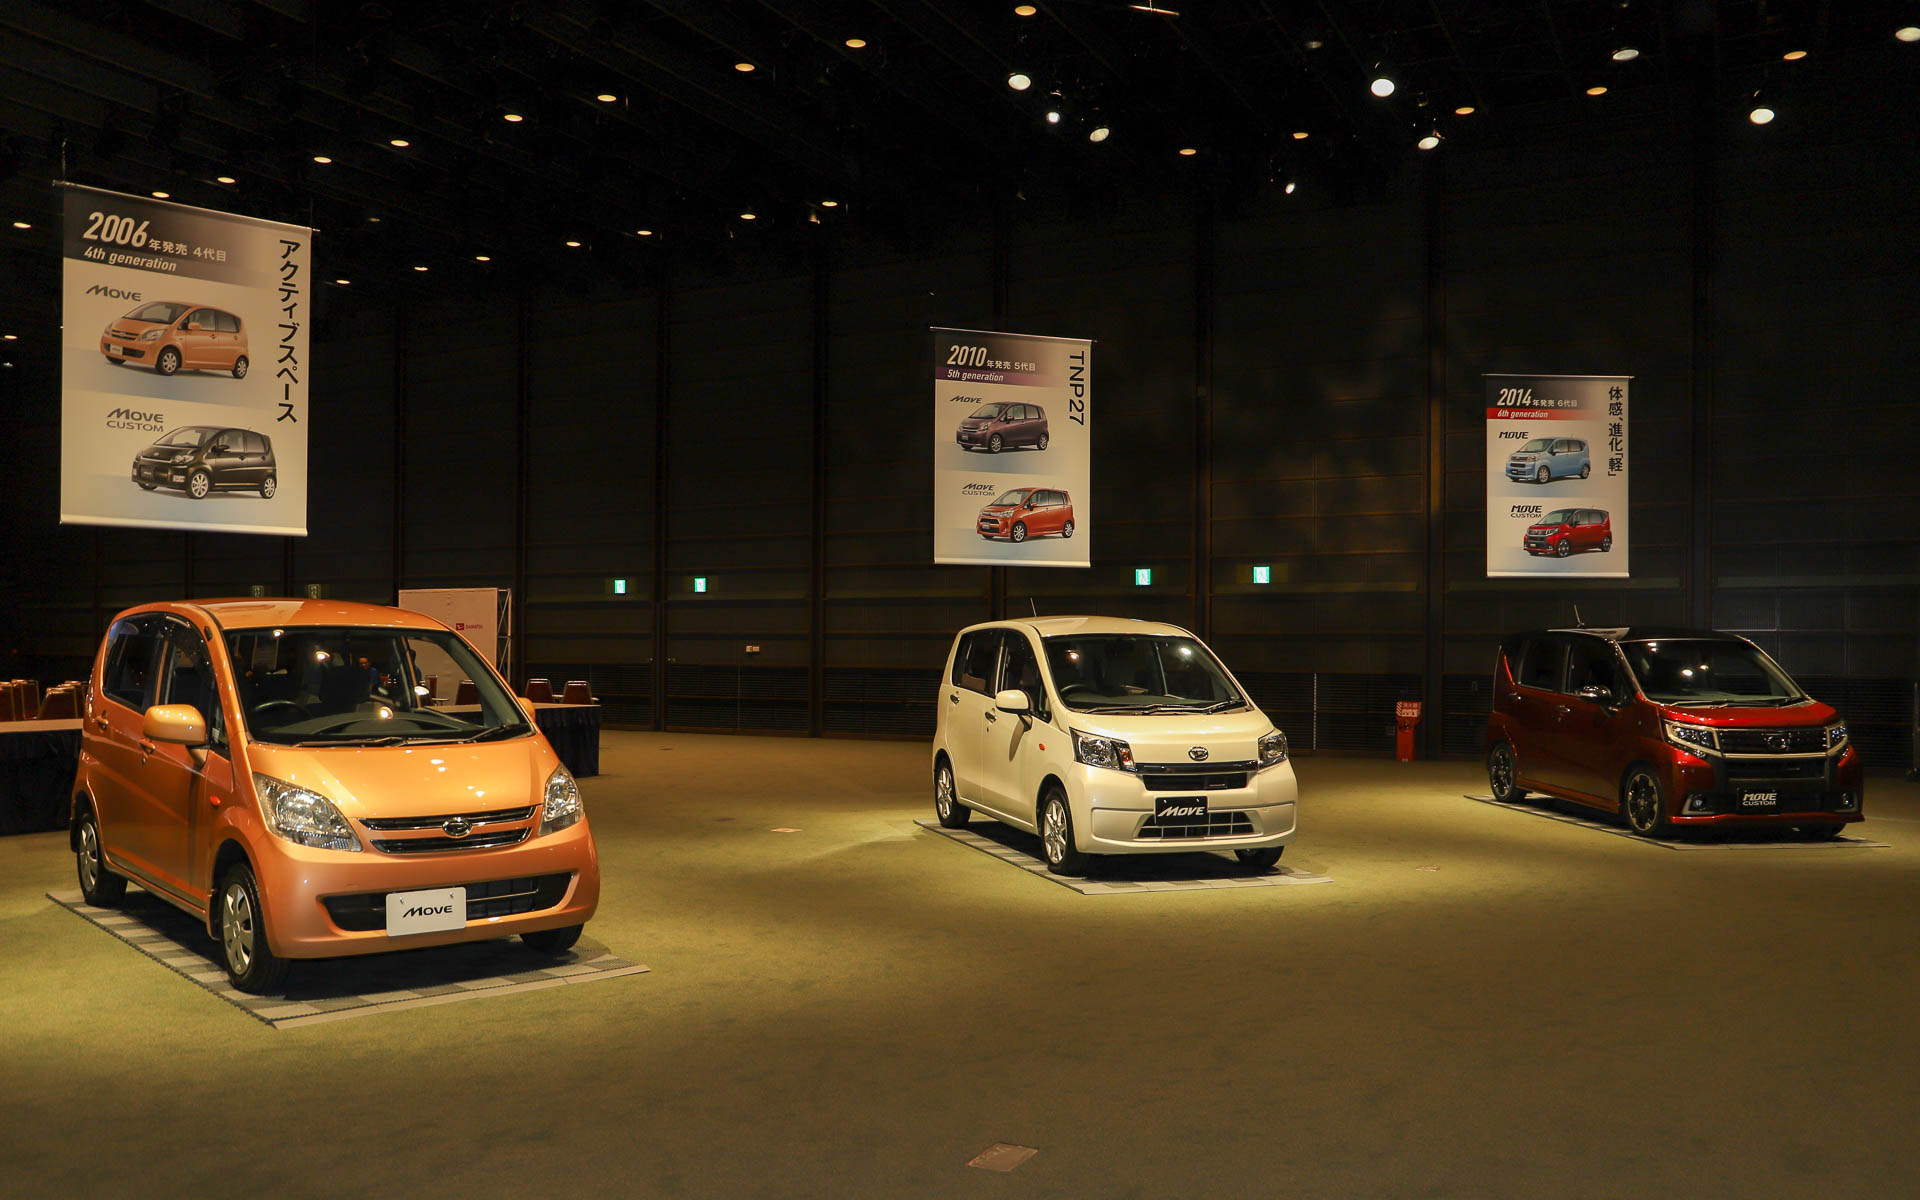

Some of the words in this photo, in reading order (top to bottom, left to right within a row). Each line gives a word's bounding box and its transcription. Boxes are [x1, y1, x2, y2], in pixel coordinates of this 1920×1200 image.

[84, 246, 106, 261] 4th
[109, 252, 177, 272] generation
[85, 284, 142, 302] MOVE
[276, 239, 301, 423] アクティブスペース
[947, 369, 960, 379] 5th
[962, 372, 1004, 382] generation
[1069, 350, 1085, 426] TNP27
[950, 395, 982, 404] MOVE
[107, 407, 164, 424] MOVE
[1497, 409, 1509, 418] 6th
[1510, 410, 1549, 419] generation
[106, 421, 164, 433] CUSTOM
[1499, 431, 1529, 440] MOVE
[962, 483, 995, 491] MOVE
[1511, 505, 1542, 513] MOVE
[1743, 792, 1777, 801] MOVE
[1157, 806, 1206, 817] MOVE
[402, 905, 453, 918] MOVE
